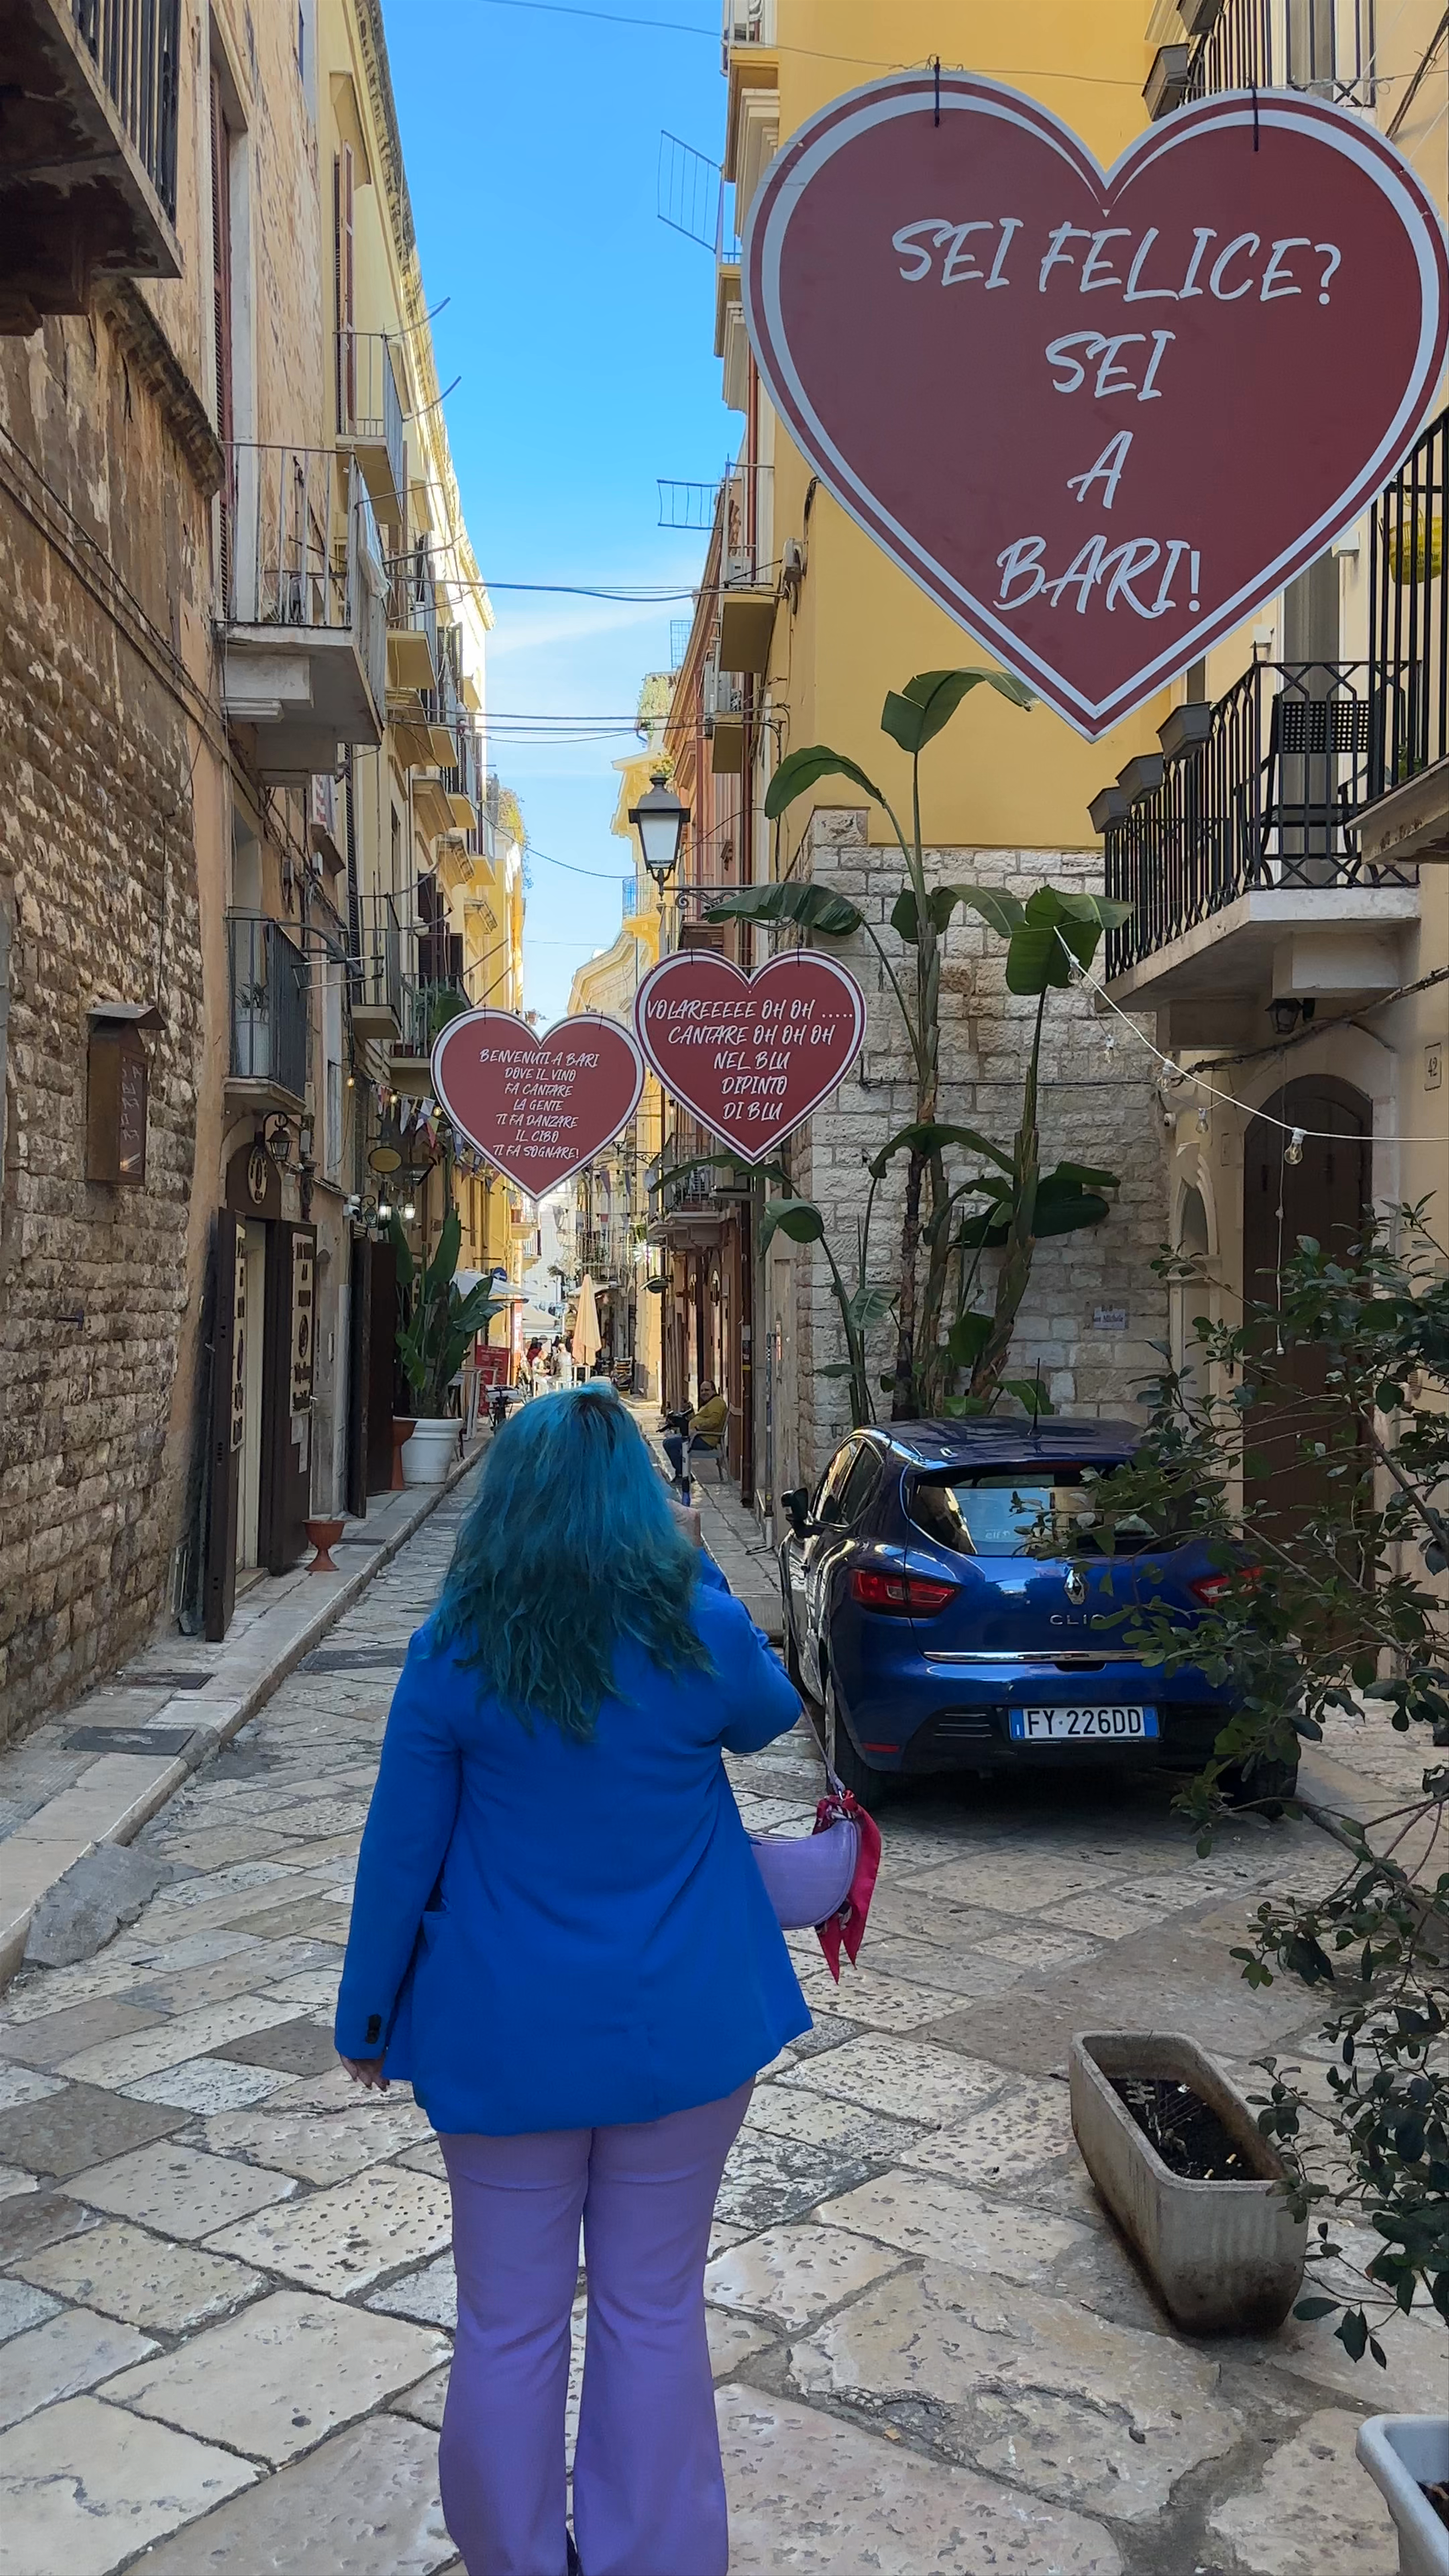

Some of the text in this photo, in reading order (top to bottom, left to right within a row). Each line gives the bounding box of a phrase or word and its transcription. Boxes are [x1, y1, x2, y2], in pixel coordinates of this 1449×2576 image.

[892, 218, 1342, 305] SEI FELICE?
[1045, 330, 1175, 401] SEI
[1066, 430, 1133, 509] A
[992, 534, 1200, 619] BARI!
[647, 999, 757, 1020] VOLAREEEEE
[761, 999, 787, 1020] OH
[790, 999, 815, 1020] OH
[668, 1024, 836, 1045] CANTARE OH OH OH
[480, 1049, 600, 1068] BENVENUTI A BARI
[714, 1050, 791, 1070] NEL BLU
[1428, 1057, 1438, 1077] 42
[505, 1067, 576, 1082] DOVE IL VINO
[505, 1083, 573, 1097] FA CANTARE
[721, 1075, 787, 1095] DIPINTO
[514, 1098, 564, 1111] LA GENTE
[723, 1101, 783, 1121] DI BLU
[496, 1113, 579, 1128] TI FA DANZARE
[515, 1129, 559, 1143] IL CIBO
[493, 1144, 579, 1159] TI FA SOGNARE!
[1027, 1709, 1141, 1735] FY 226DD
